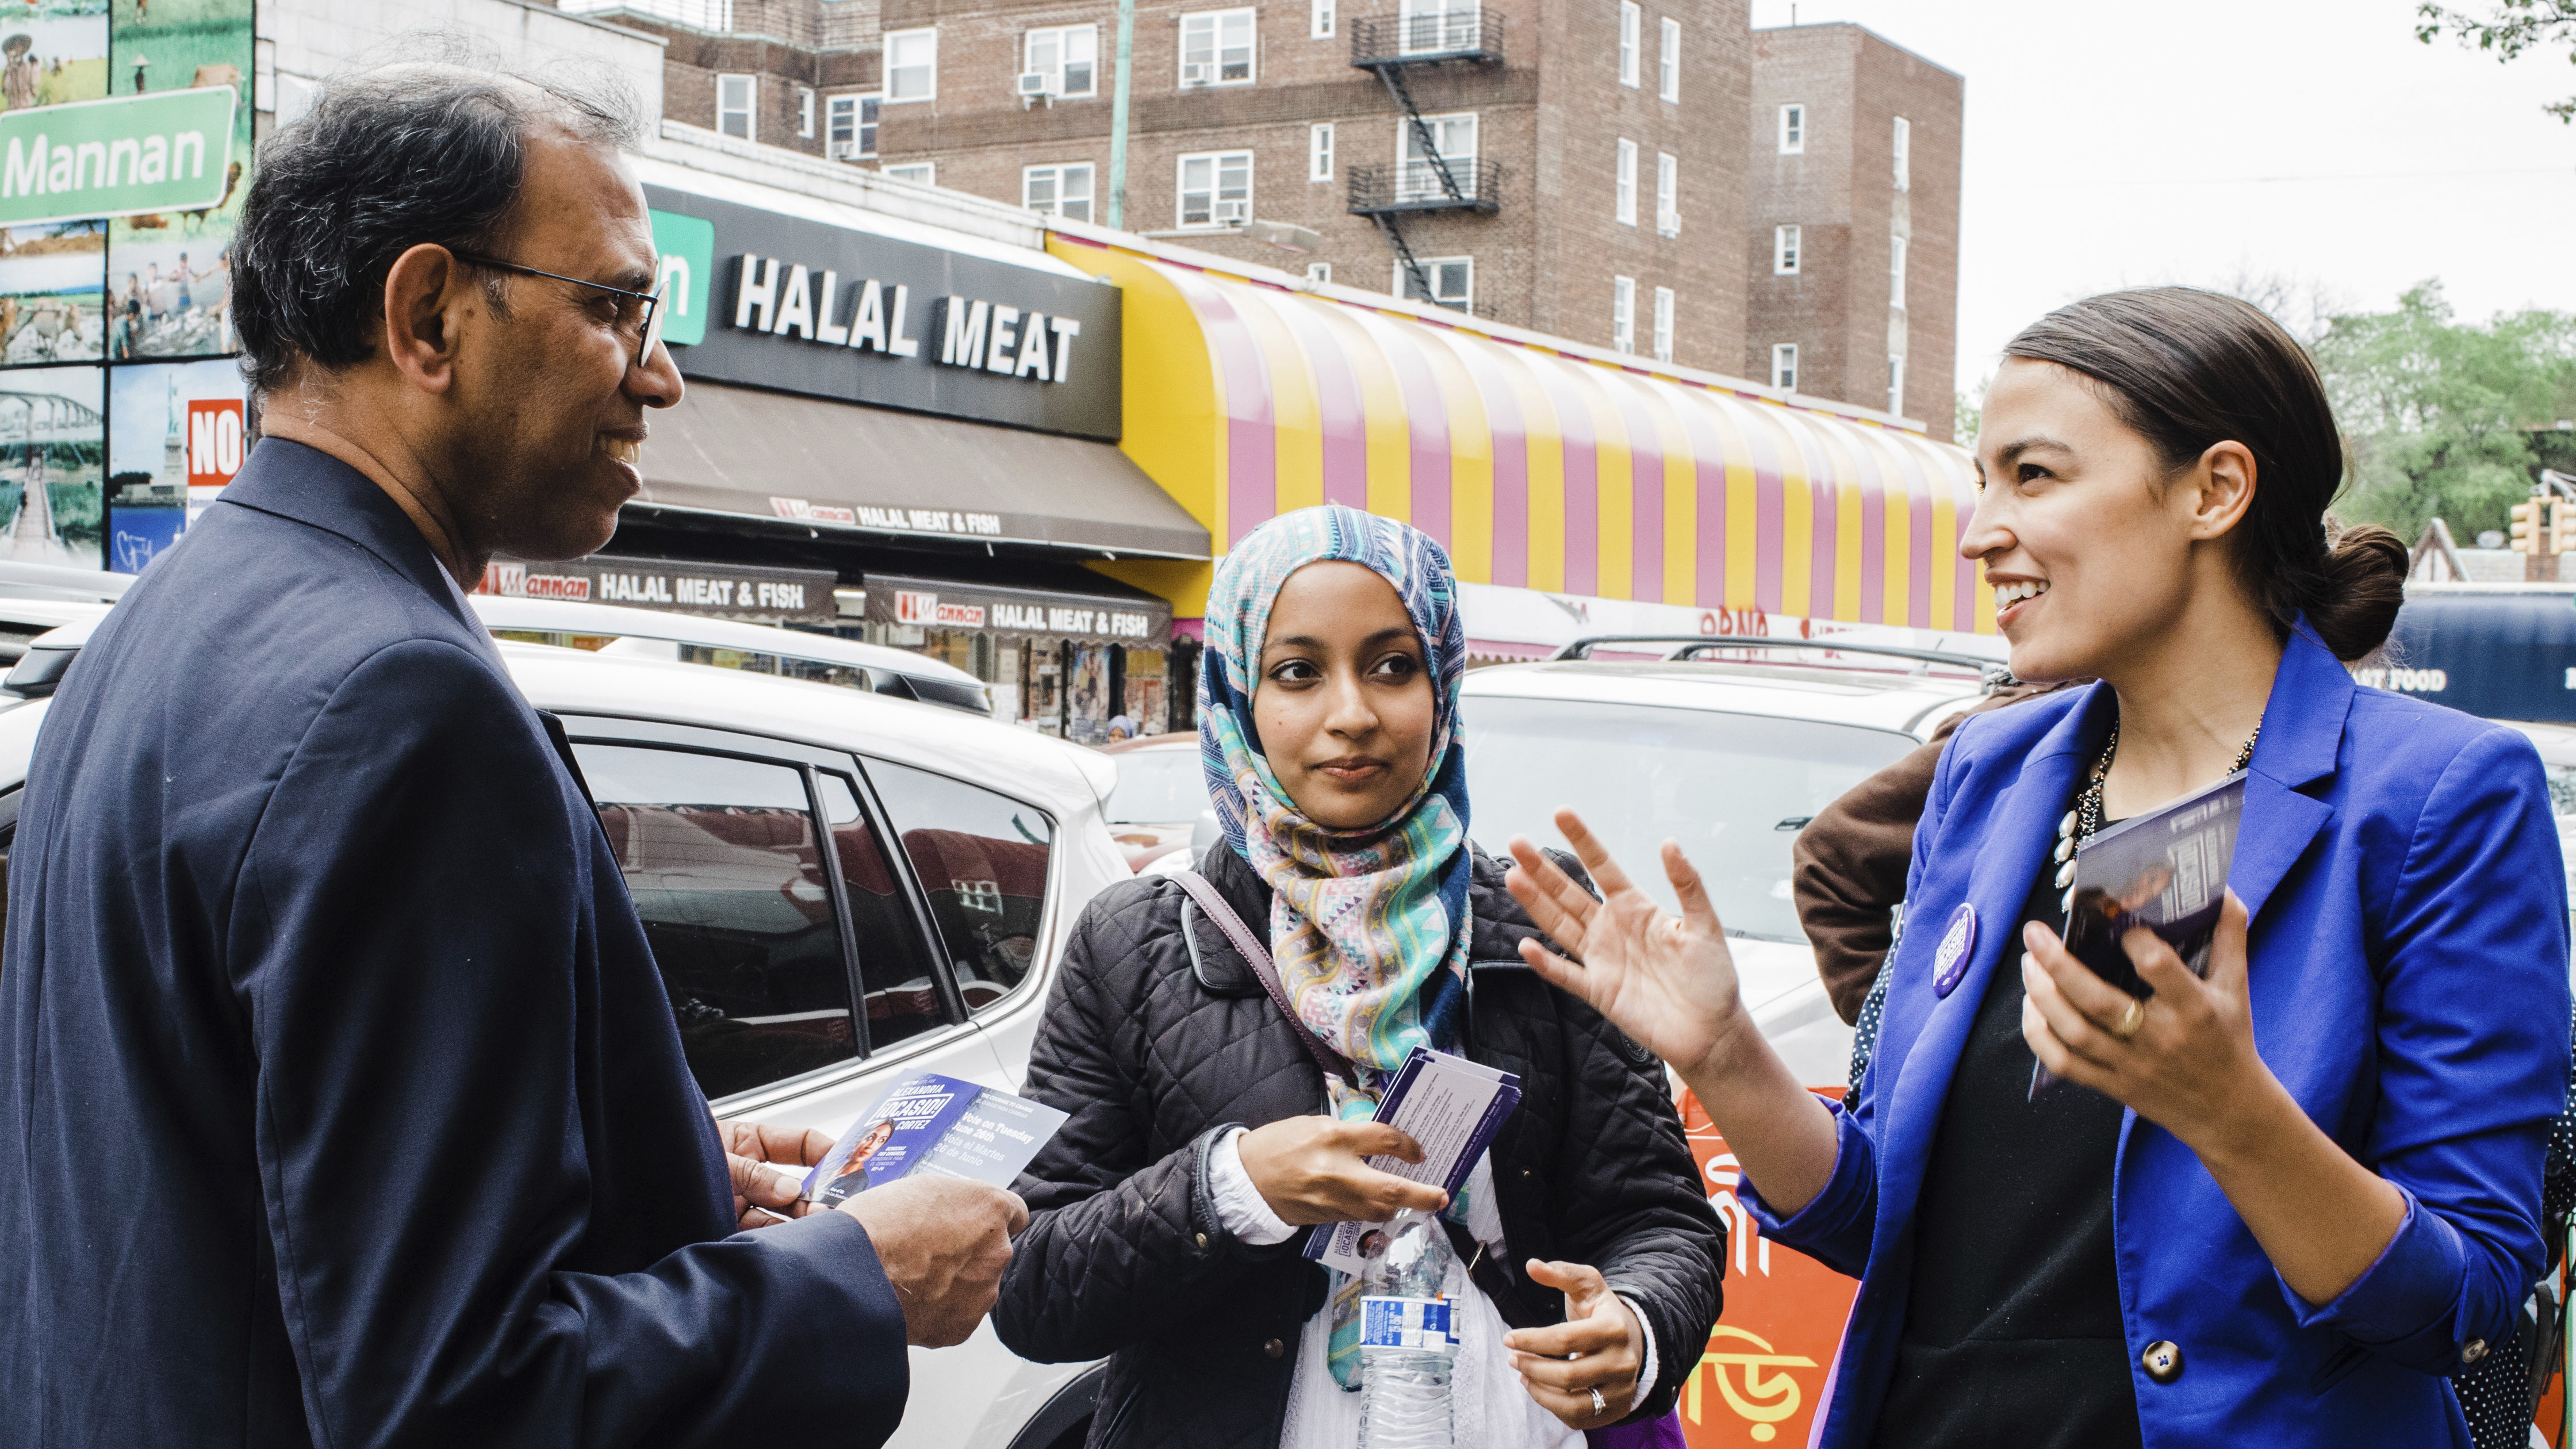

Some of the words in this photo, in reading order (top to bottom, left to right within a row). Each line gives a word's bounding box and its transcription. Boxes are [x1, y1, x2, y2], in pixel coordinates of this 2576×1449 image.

[2, 131, 205, 198] Mannan
[735, 252, 918, 358] HALAL
[941, 295, 1080, 384] MEAT
[191, 409, 241, 476] NO
[856, 507, 910, 529] HALAL
[908, 510, 950, 532] MEAT
[952, 512, 965, 533] &
[966, 513, 1001, 535] FISH
[600, 573, 673, 603] HALAL
[677, 577, 733, 605] MEAT
[737, 582, 754, 607] &
[758, 582, 805, 610] FISH
[991, 605, 1047, 630] HALAL
[1050, 608, 1092, 634] MEAT
[1095, 612, 1109, 634] &
[1111, 614, 1149, 638] FISH
[2389, 669, 2447, 691] FOOD
[891, 1084, 945, 1097] ALEXANDRIA
[876, 1098, 946, 1118] ¡OCASIO!
[895, 1120, 931, 1130] CORTEZ
[952, 1121, 974, 1134] June
[972, 1128, 995, 1143] 26th
[961, 1111, 983, 1125] Vote
[982, 1120, 995, 1130] on
[995, 1122, 1035, 1145] Tuesday
[933, 1143, 948, 1153] 26
[946, 1147, 960, 1157] de
[958, 1151, 984, 1167] Junio
[943, 1133, 964, 1147] Vota
[963, 1141, 976, 1150] el
[972, 1143, 1006, 1162] Martes
